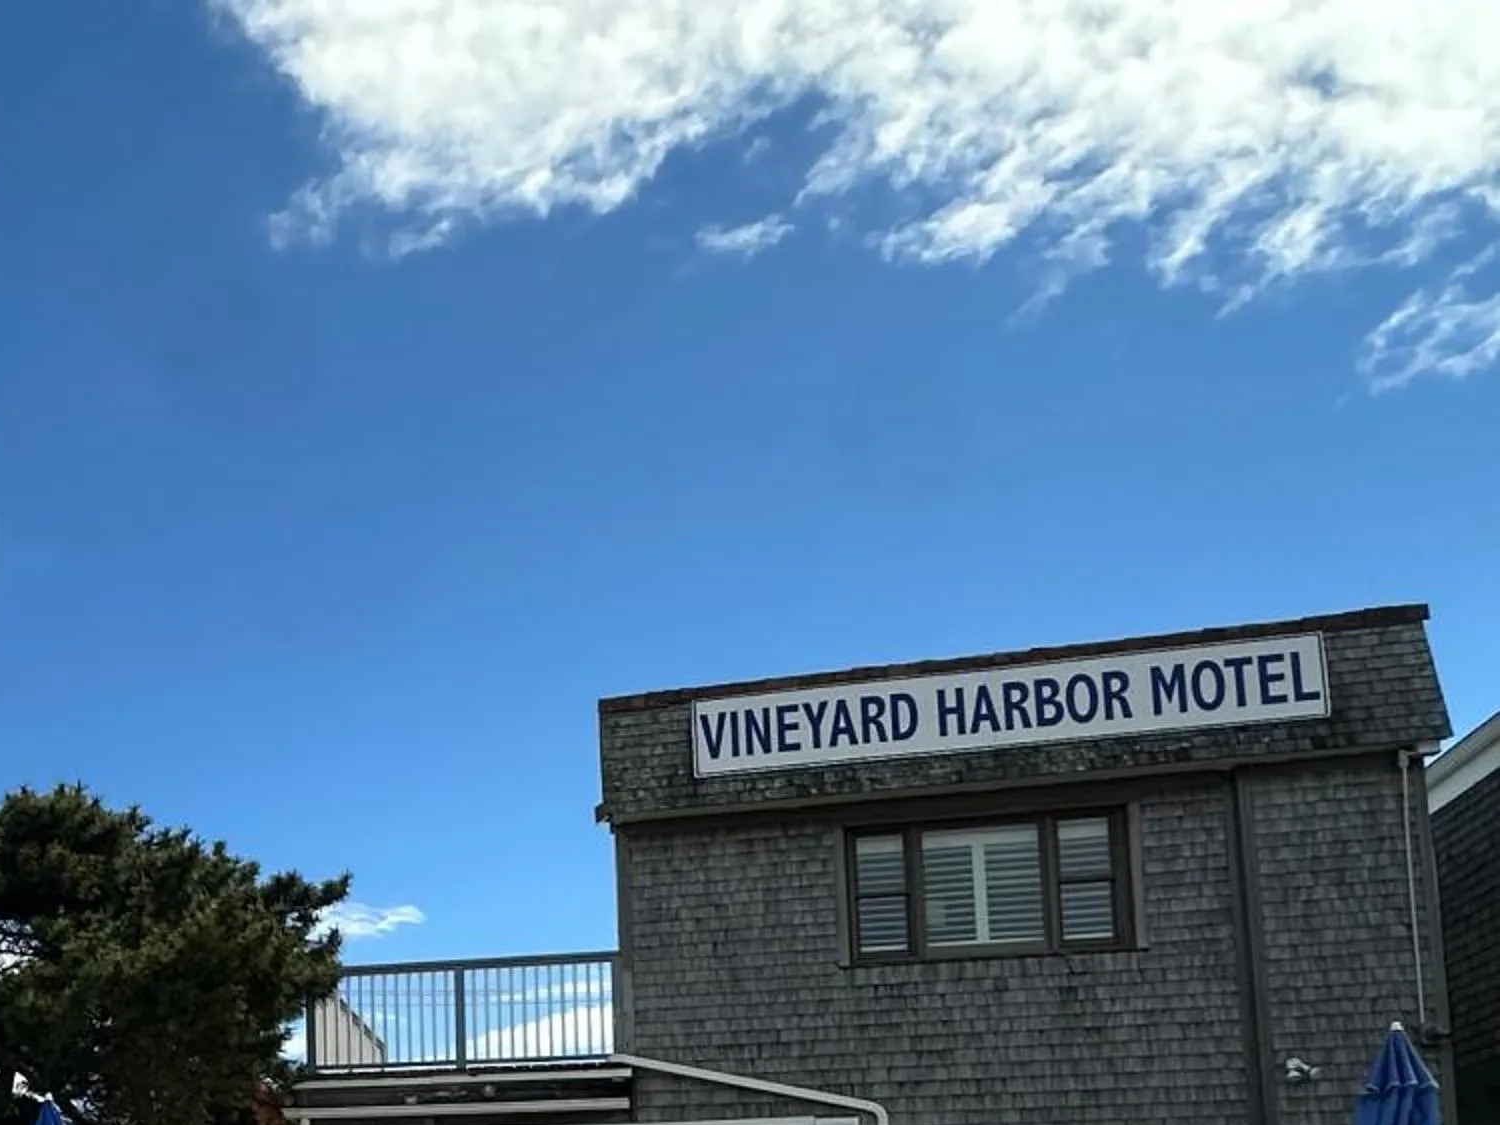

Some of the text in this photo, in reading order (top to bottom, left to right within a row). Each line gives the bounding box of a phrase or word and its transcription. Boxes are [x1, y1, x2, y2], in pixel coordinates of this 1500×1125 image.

[699, 651, 1321, 760] VINEYARD HARBOR MOTEL
